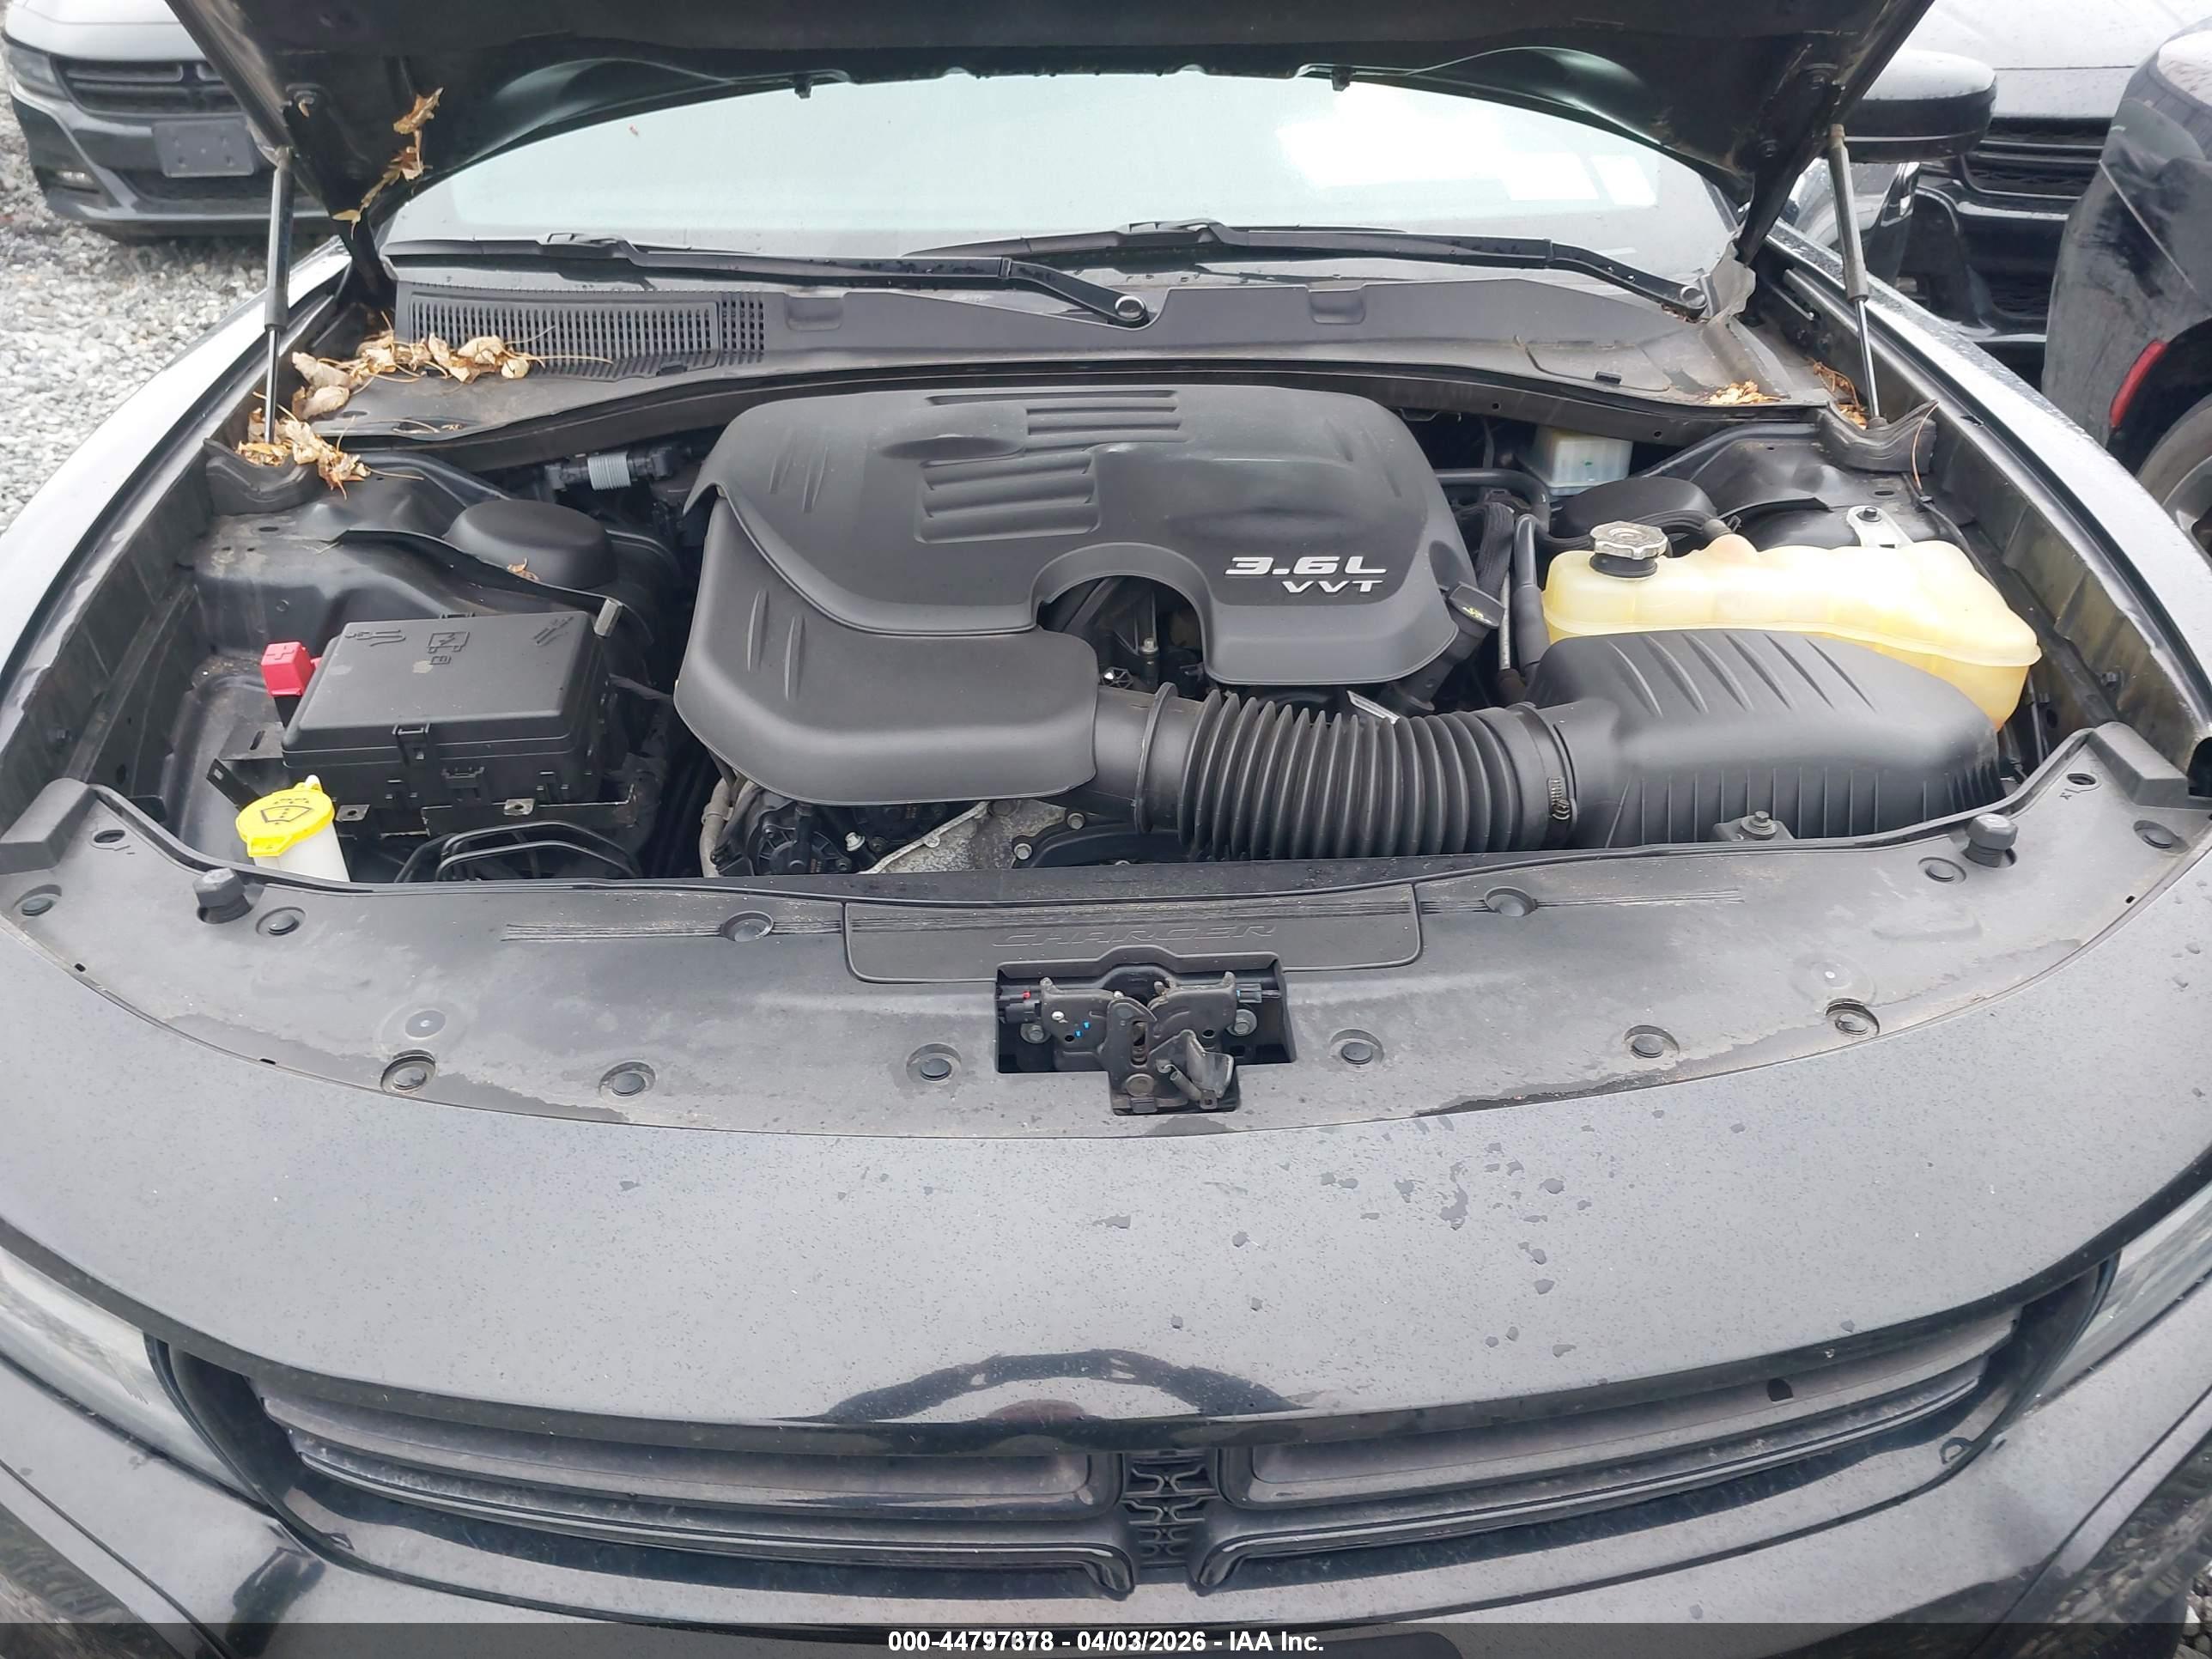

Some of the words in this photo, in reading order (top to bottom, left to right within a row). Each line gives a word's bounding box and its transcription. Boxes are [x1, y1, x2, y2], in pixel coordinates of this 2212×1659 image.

[1224, 556, 1387, 575] 3.6L
[1281, 580, 1383, 593] VVT
[992, 926, 1277, 946] CHARGER
